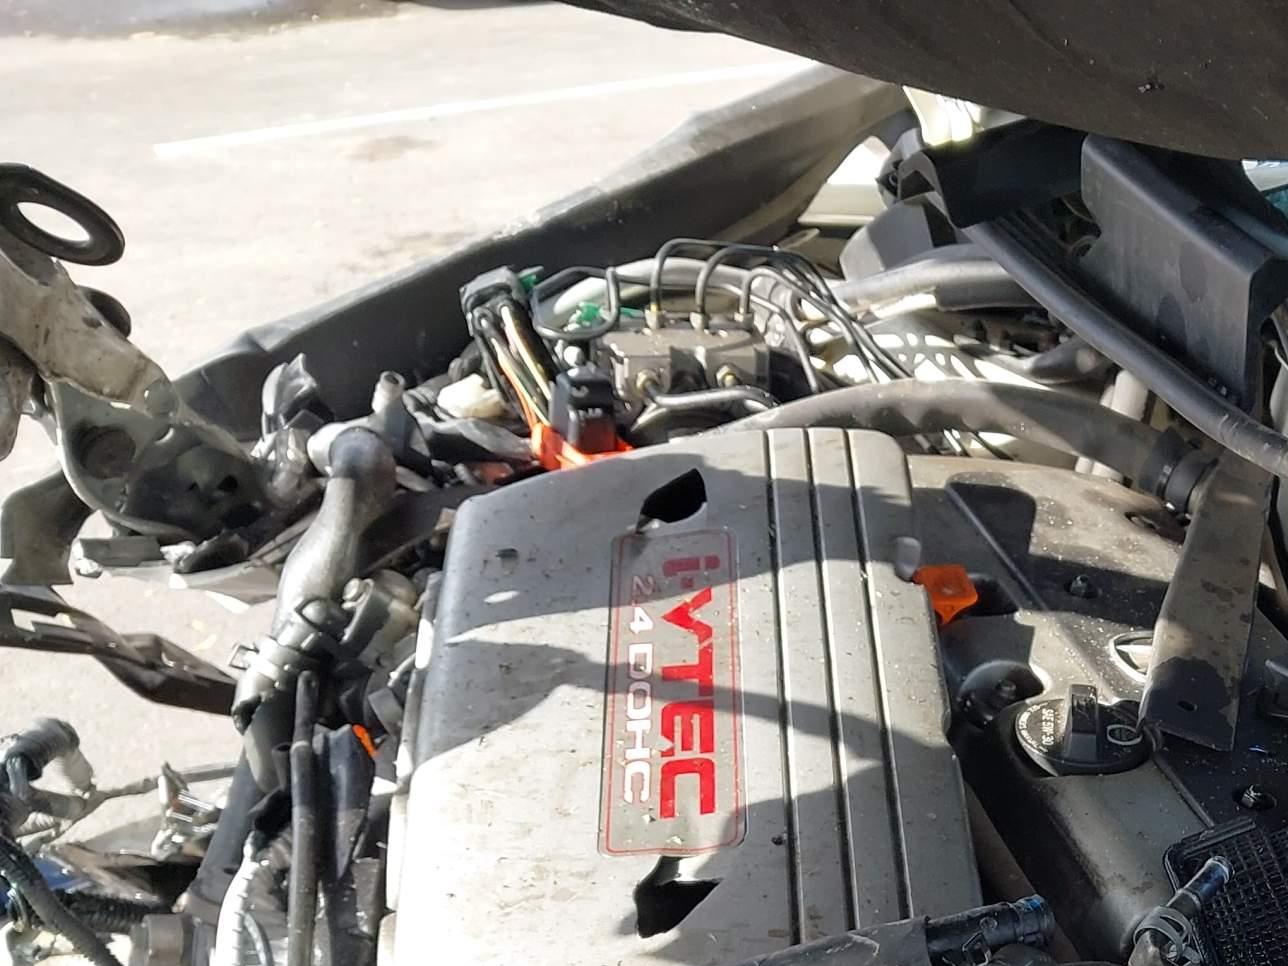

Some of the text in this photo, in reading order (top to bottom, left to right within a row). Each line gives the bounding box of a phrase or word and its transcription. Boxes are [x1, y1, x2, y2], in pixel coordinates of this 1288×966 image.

[623, 643, 653, 804] DOHC
[660, 555, 721, 818] i-VTEC
[1041, 708, 1055, 746] SAE 5W-30
